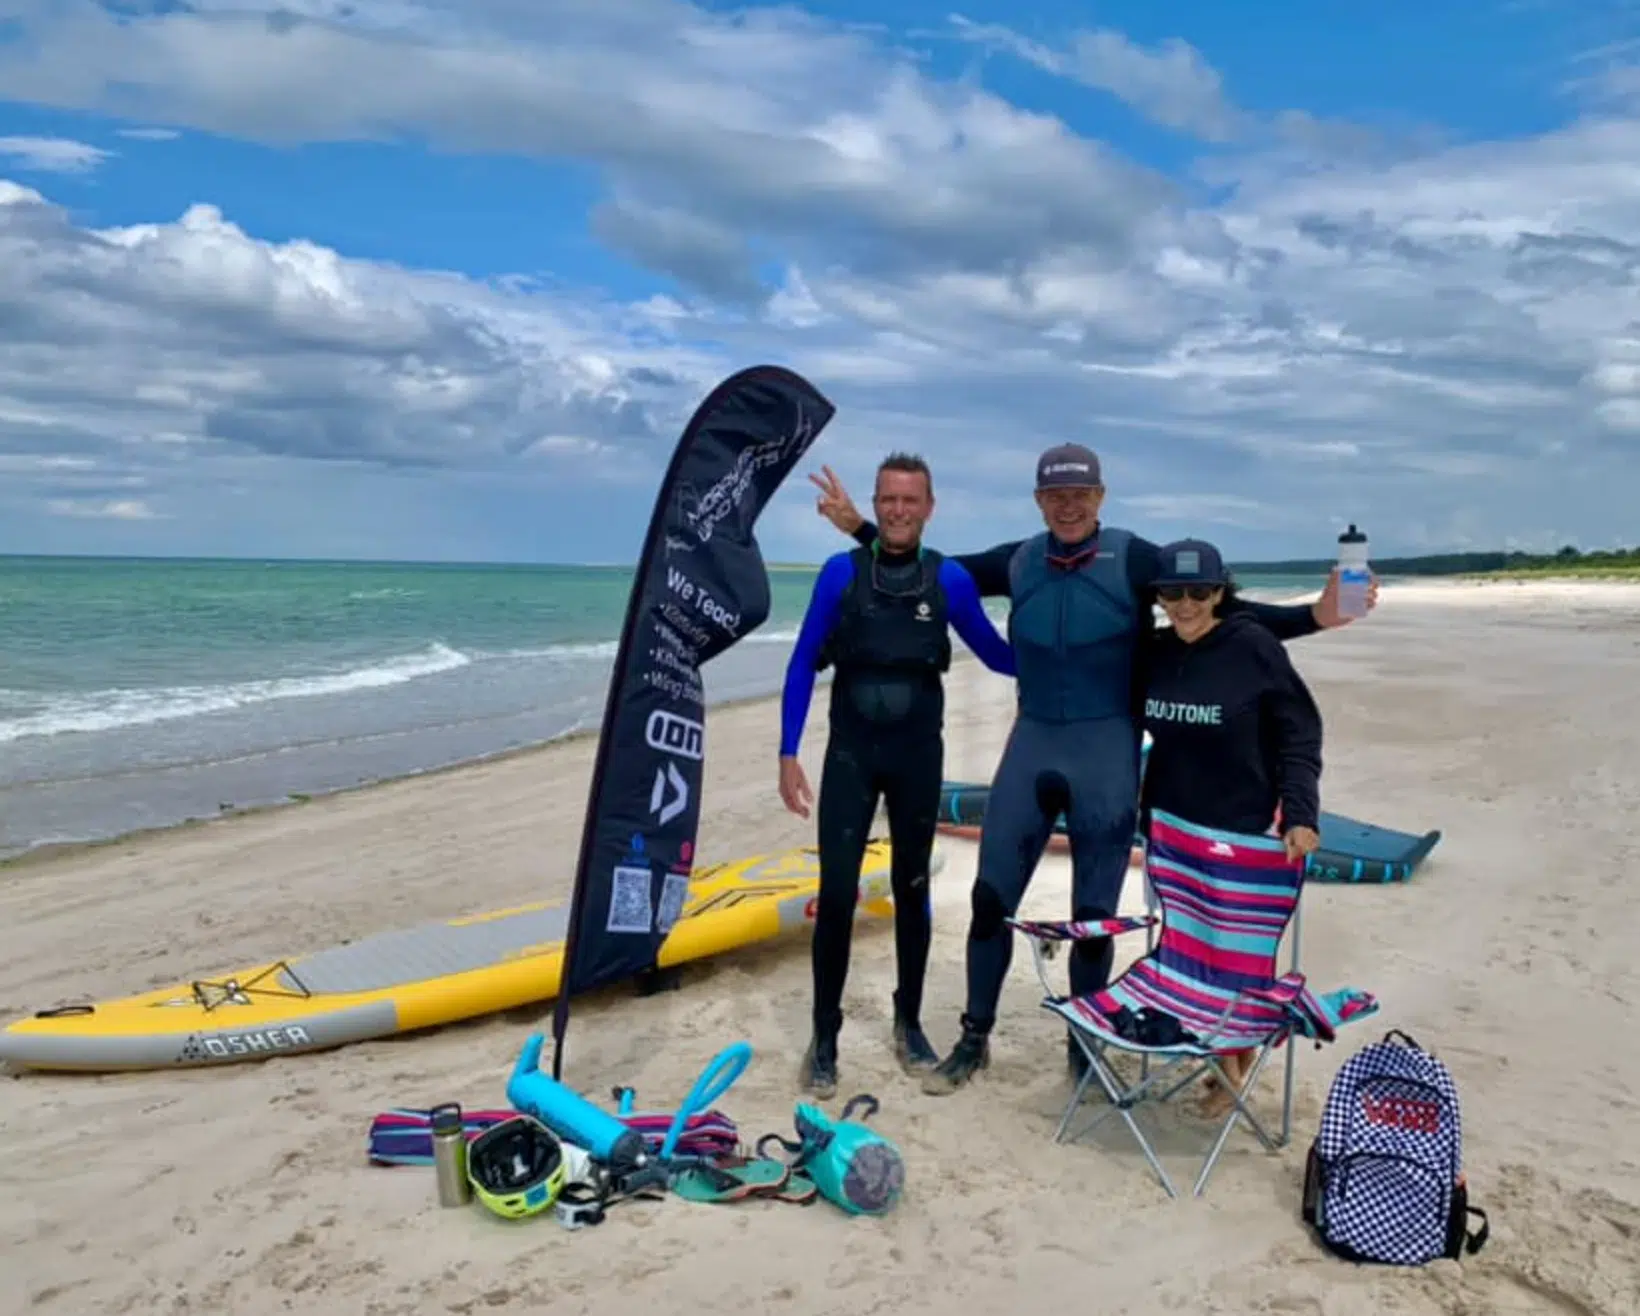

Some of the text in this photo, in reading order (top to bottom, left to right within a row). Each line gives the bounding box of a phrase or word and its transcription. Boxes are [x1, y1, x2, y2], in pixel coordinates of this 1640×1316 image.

[666, 565, 694, 600] We
[1144, 698, 1223, 725] DUOTONE
[203, 1025, 310, 1057] OSHEA
